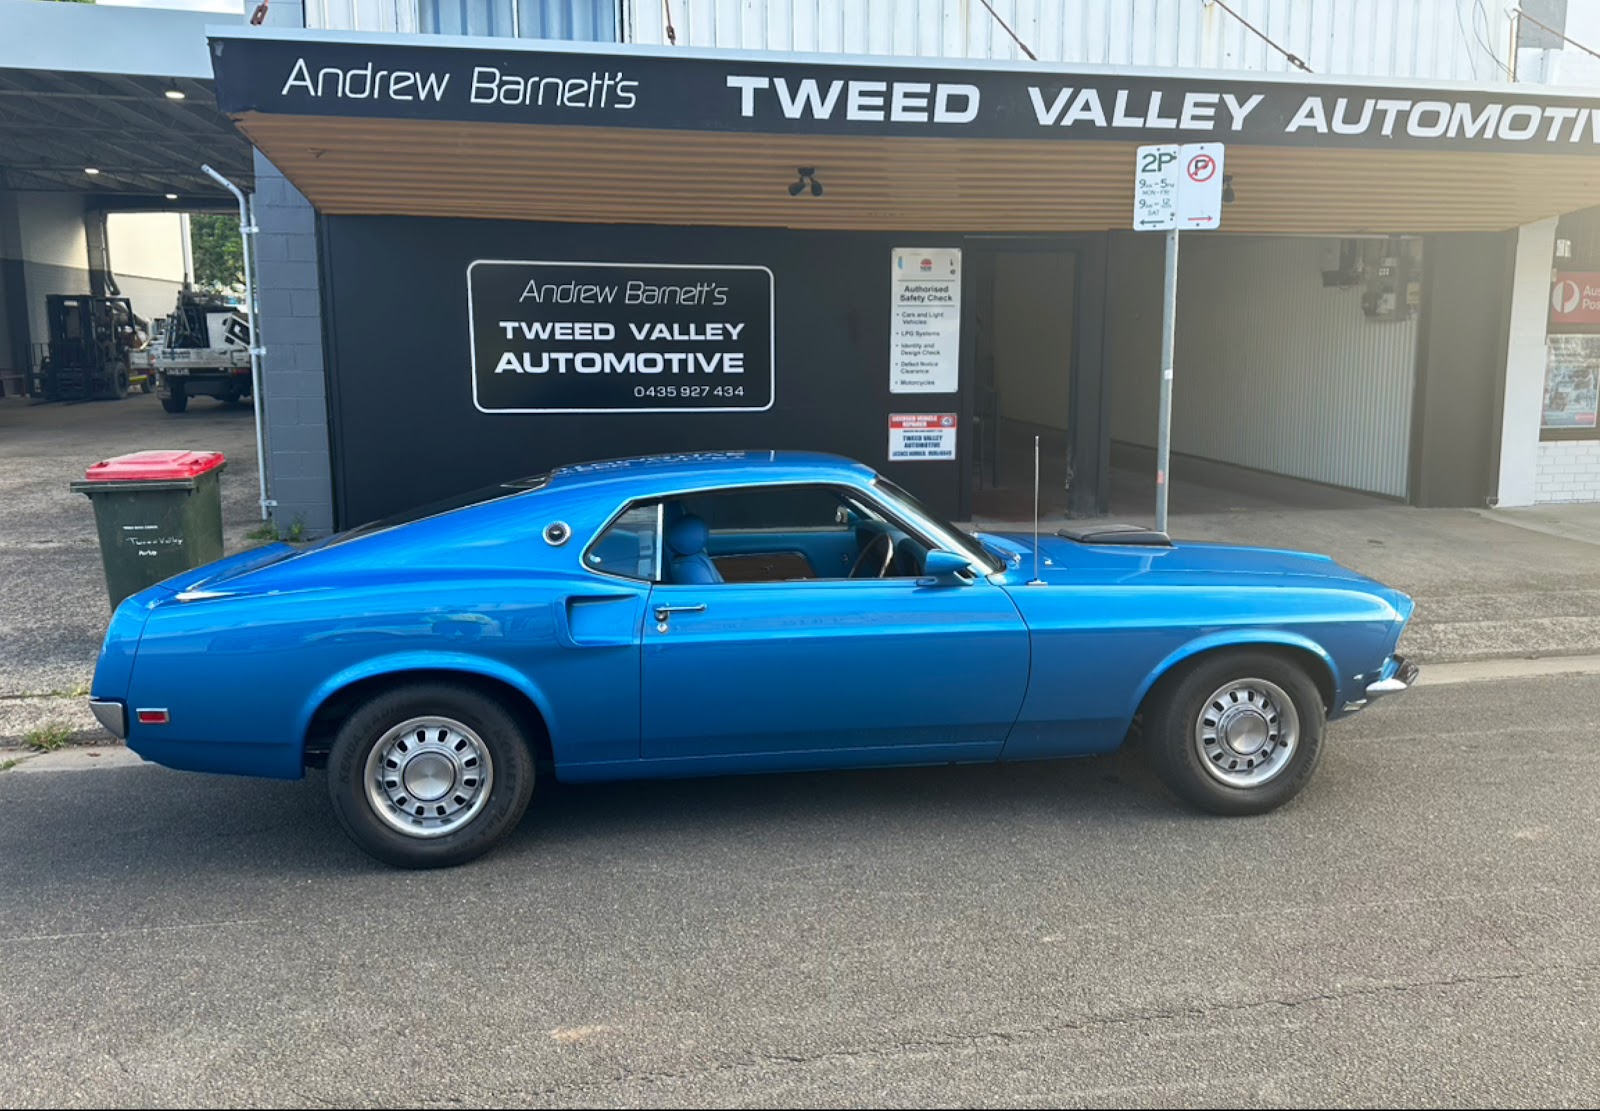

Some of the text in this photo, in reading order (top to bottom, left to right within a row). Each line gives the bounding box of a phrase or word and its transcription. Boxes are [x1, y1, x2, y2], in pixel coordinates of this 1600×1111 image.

[281, 58, 1600, 144] Andrew Barnett's TWEED VALLEY AUTOMOTI
[1141, 153, 1173, 173] 2P
[519, 279, 729, 306] Andrew Barnett's
[900, 295, 925, 303] Safety
[904, 285, 949, 293] Authorised
[928, 311, 944, 320] Light
[499, 321, 745, 341] TWEED VALLEY
[494, 352, 745, 373] AUTOMOTIVE
[634, 386, 745, 397] 0435 927 434
